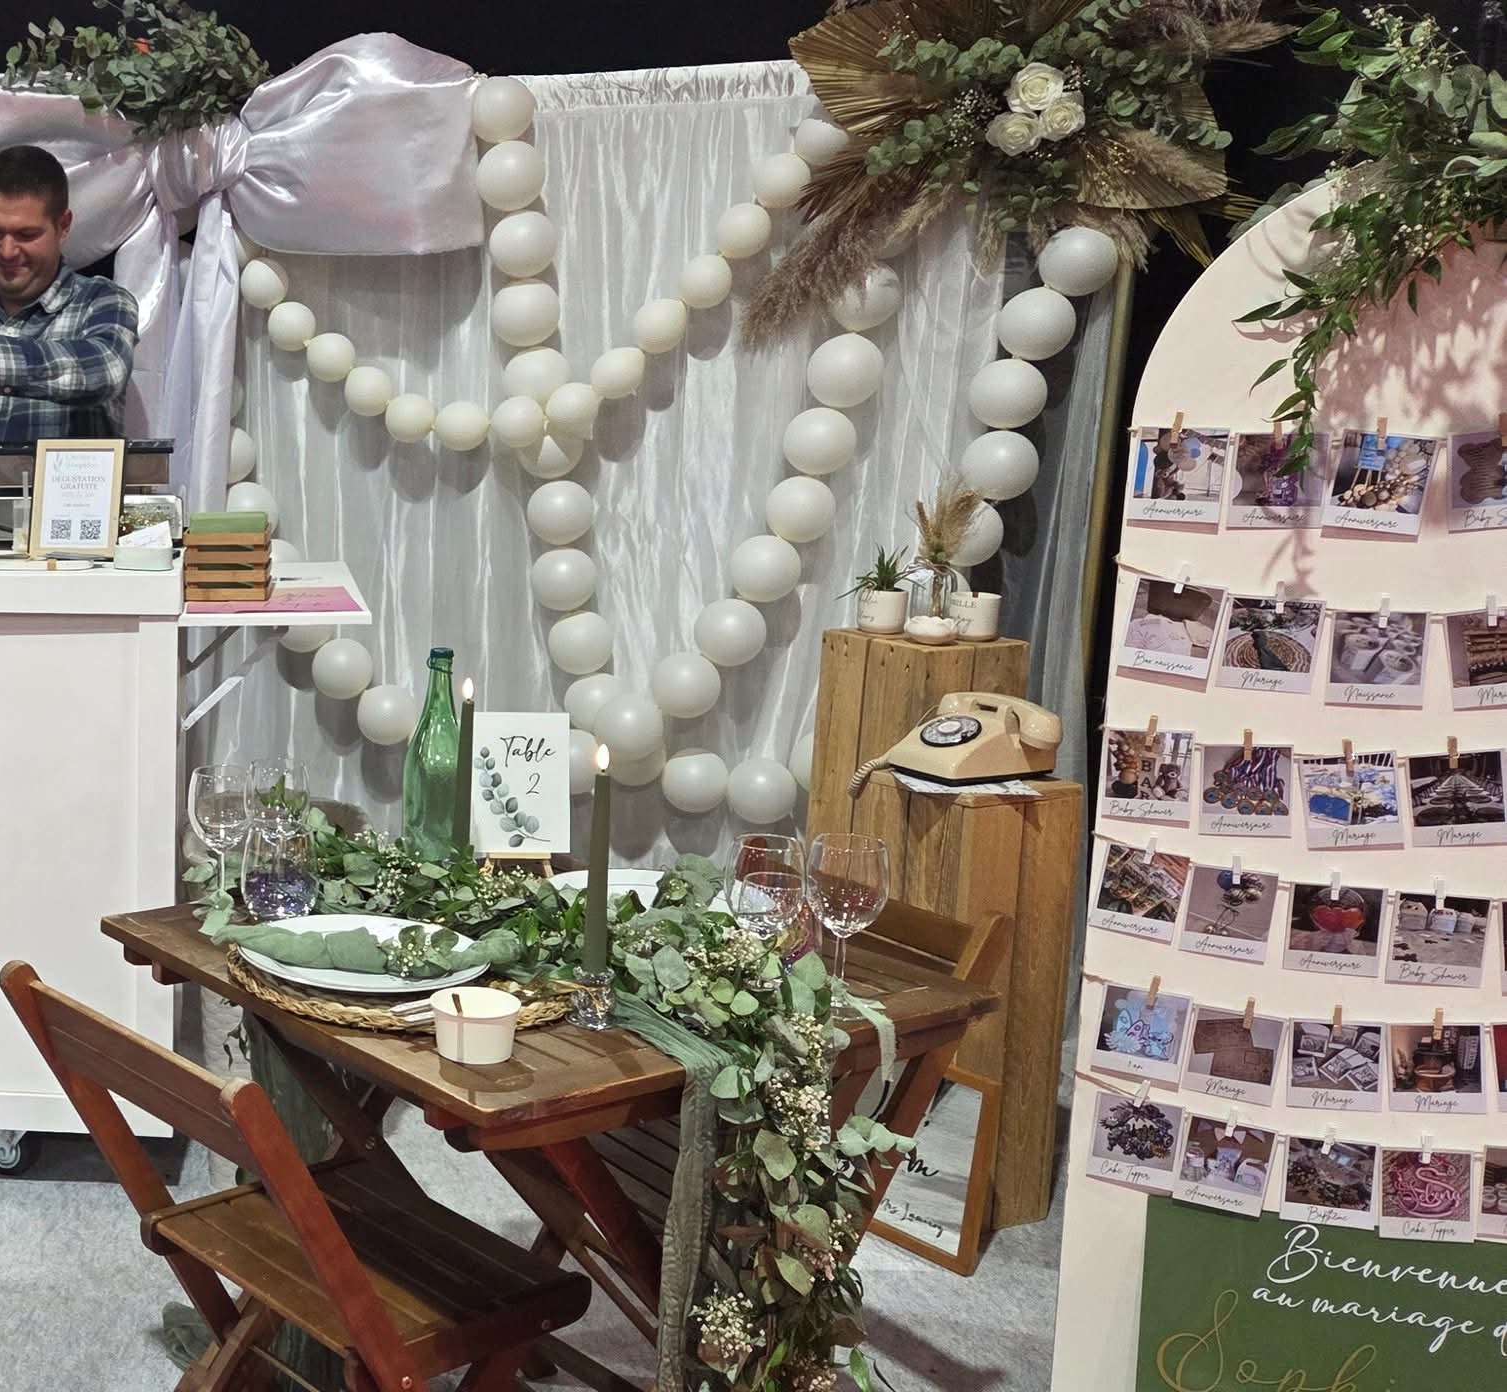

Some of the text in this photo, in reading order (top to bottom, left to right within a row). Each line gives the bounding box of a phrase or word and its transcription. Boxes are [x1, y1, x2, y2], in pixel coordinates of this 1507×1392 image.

[1143, 501, 1205, 518] Anniversaire
[1335, 510, 1399, 529] Anniversaire
[1242, 671, 1285, 688] Mariage
[499, 736, 557, 768] Table
[526, 773, 541, 794] 2
[1109, 801, 1134, 816] Baby
[1211, 816, 1272, 832] Anniversaire
[1332, 828, 1377, 845] Mariage
[1437, 827, 1483, 846] Mariage
[1102, 914, 1159, 934] Anniversaire
[1196, 936, 1255, 954] Anniversaire
[1300, 954, 1362, 969] Anniversaire
[1399, 963, 1425, 980] Baby
[1205, 1079, 1247, 1099] Mariage
[1311, 1091, 1355, 1108] Mariage
[1414, 1095, 1459, 1112] Mariage
[1267, 1224, 1507, 1295] Bienvenue
[1252, 1287, 1305, 1308] au
[1312, 1297, 1484, 1353] mariage
[1157, 1289, 1397, 1392] Soph
